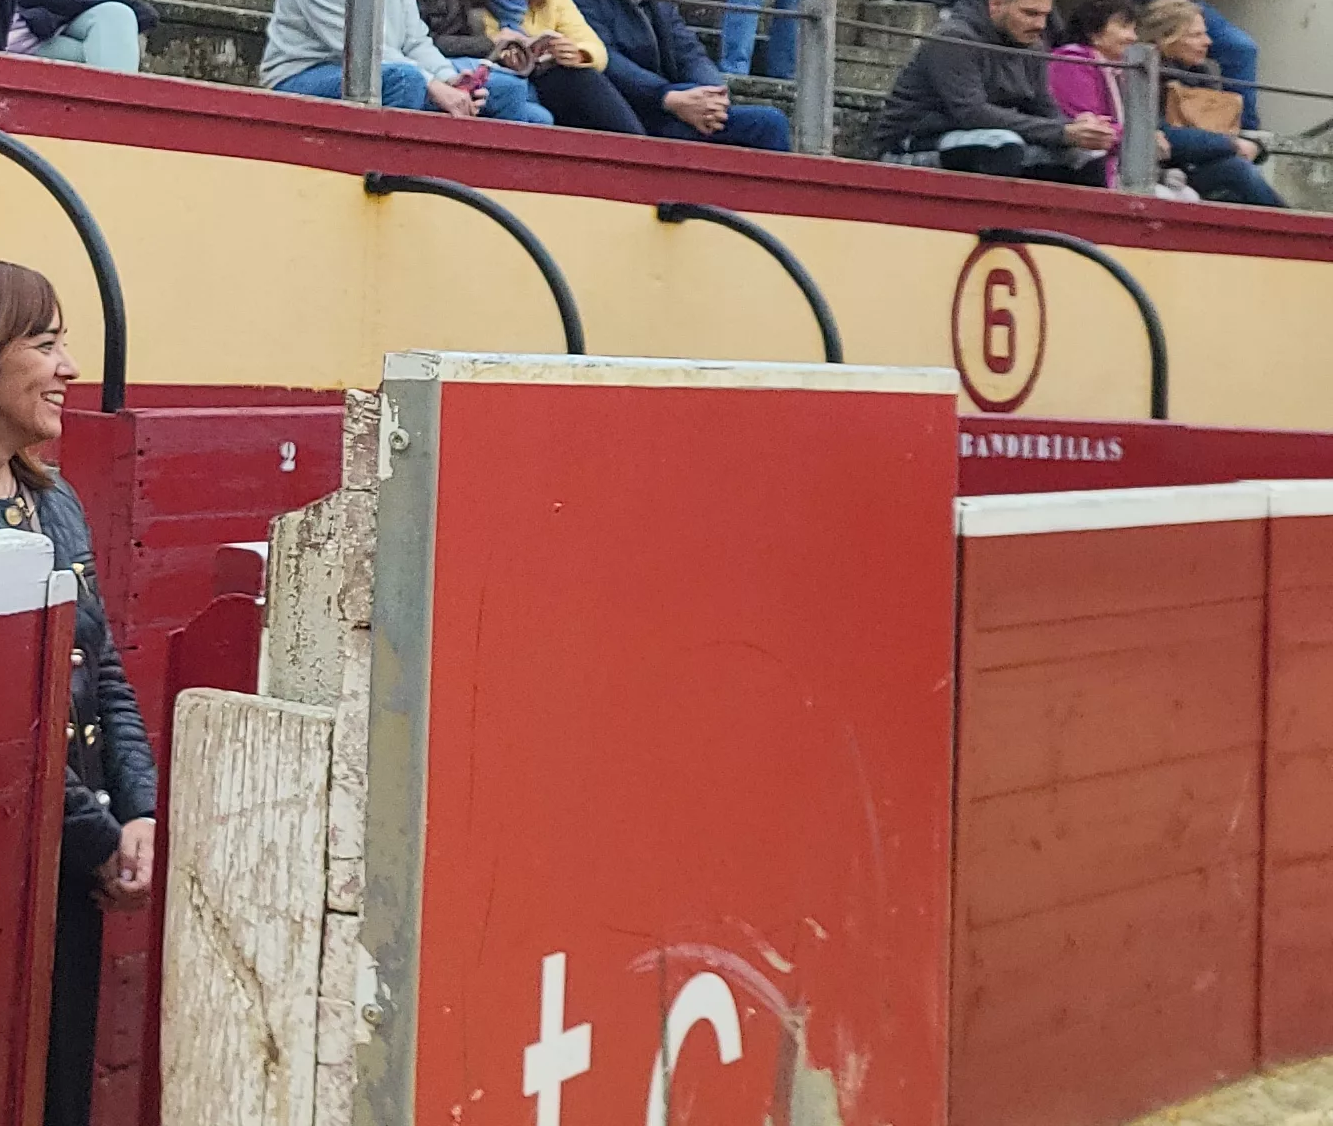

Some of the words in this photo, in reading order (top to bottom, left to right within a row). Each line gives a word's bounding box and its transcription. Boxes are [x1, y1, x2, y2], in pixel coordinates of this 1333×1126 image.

[983, 268, 1017, 374] 6
[278, 441, 297, 472] 2
[959, 432, 1124, 462] BANDERILLAS
